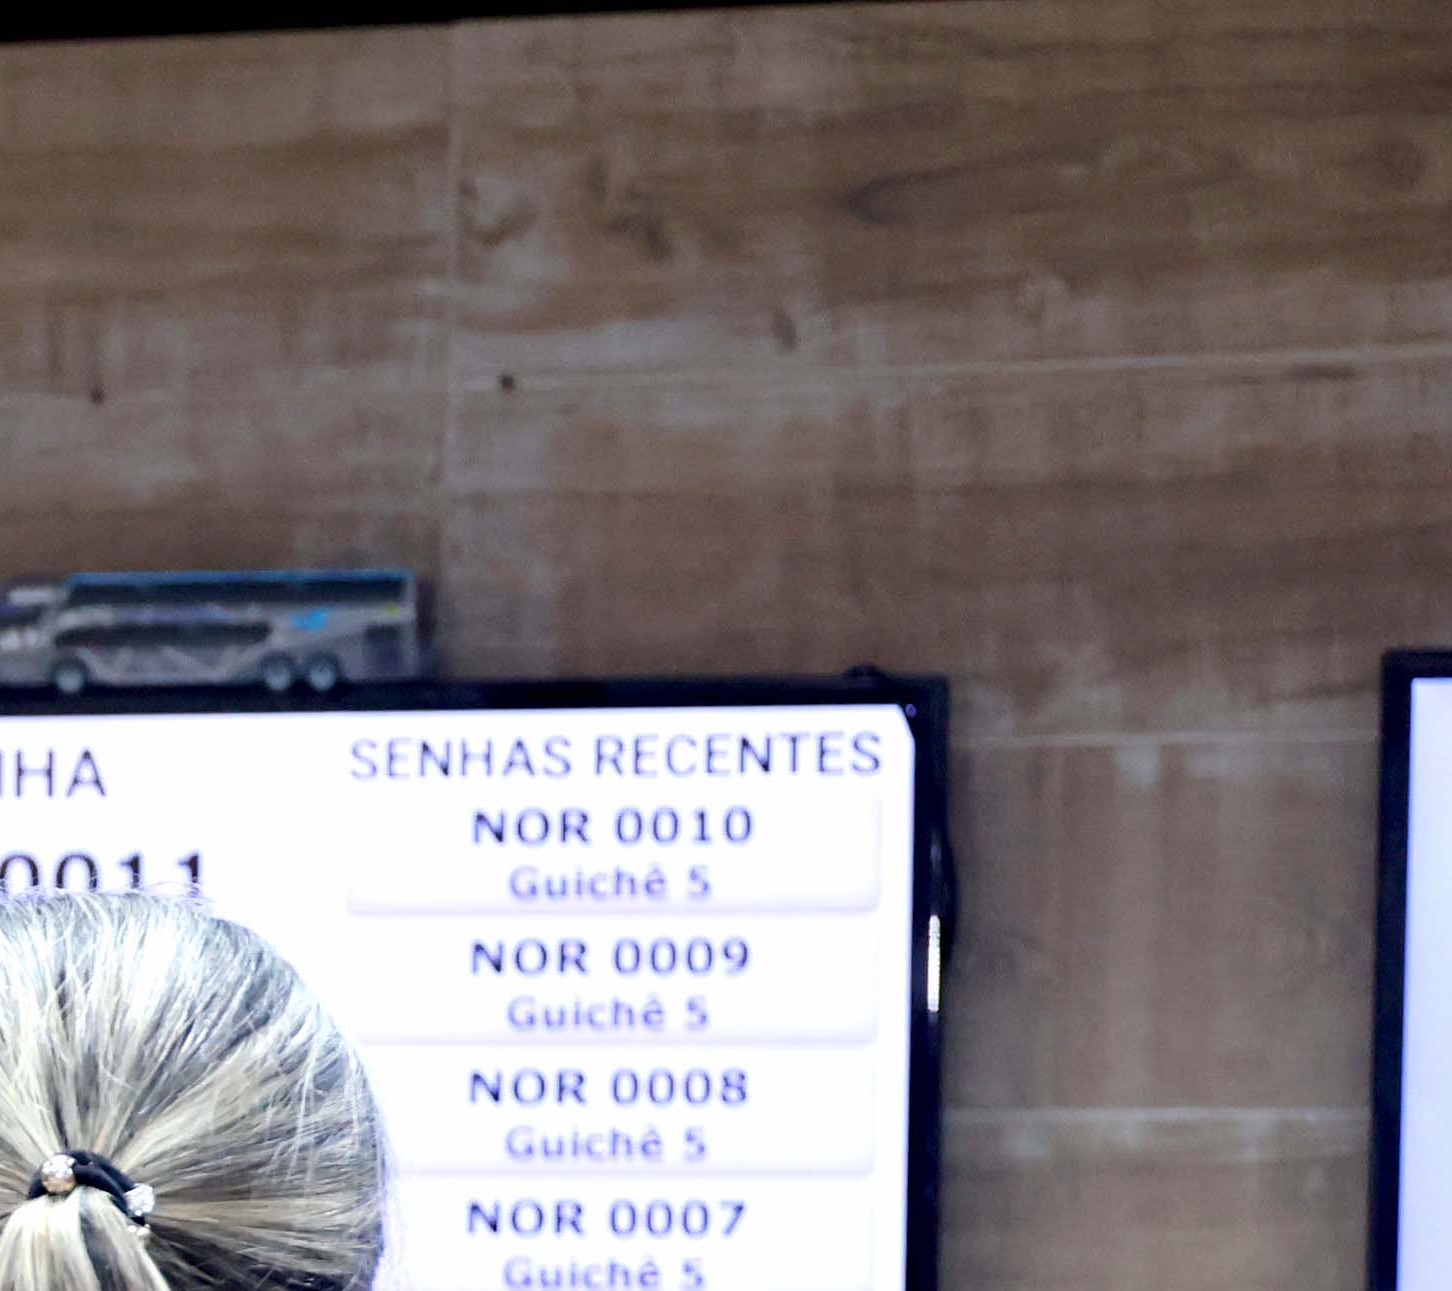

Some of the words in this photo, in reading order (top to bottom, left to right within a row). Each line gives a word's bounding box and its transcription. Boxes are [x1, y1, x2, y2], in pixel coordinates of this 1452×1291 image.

[350, 736, 573, 780] SENHAS
[594, 731, 883, 777] RECENTES
[472, 808, 591, 846] NOR
[614, 806, 753, 846] 0010
[508, 864, 669, 904] Guichê
[688, 864, 712, 903] 5
[471, 938, 588, 976] NOR
[612, 937, 751, 976] 0009
[507, 995, 666, 1034] Guichê
[685, 995, 710, 1032] 5
[469, 1069, 587, 1106] NOR
[610, 1069, 749, 1106] 0008
[504, 1125, 663, 1163] Guichê
[683, 1126, 708, 1163] 5
[467, 1200, 584, 1236] NOR
[608, 1199, 747, 1237] 0007
